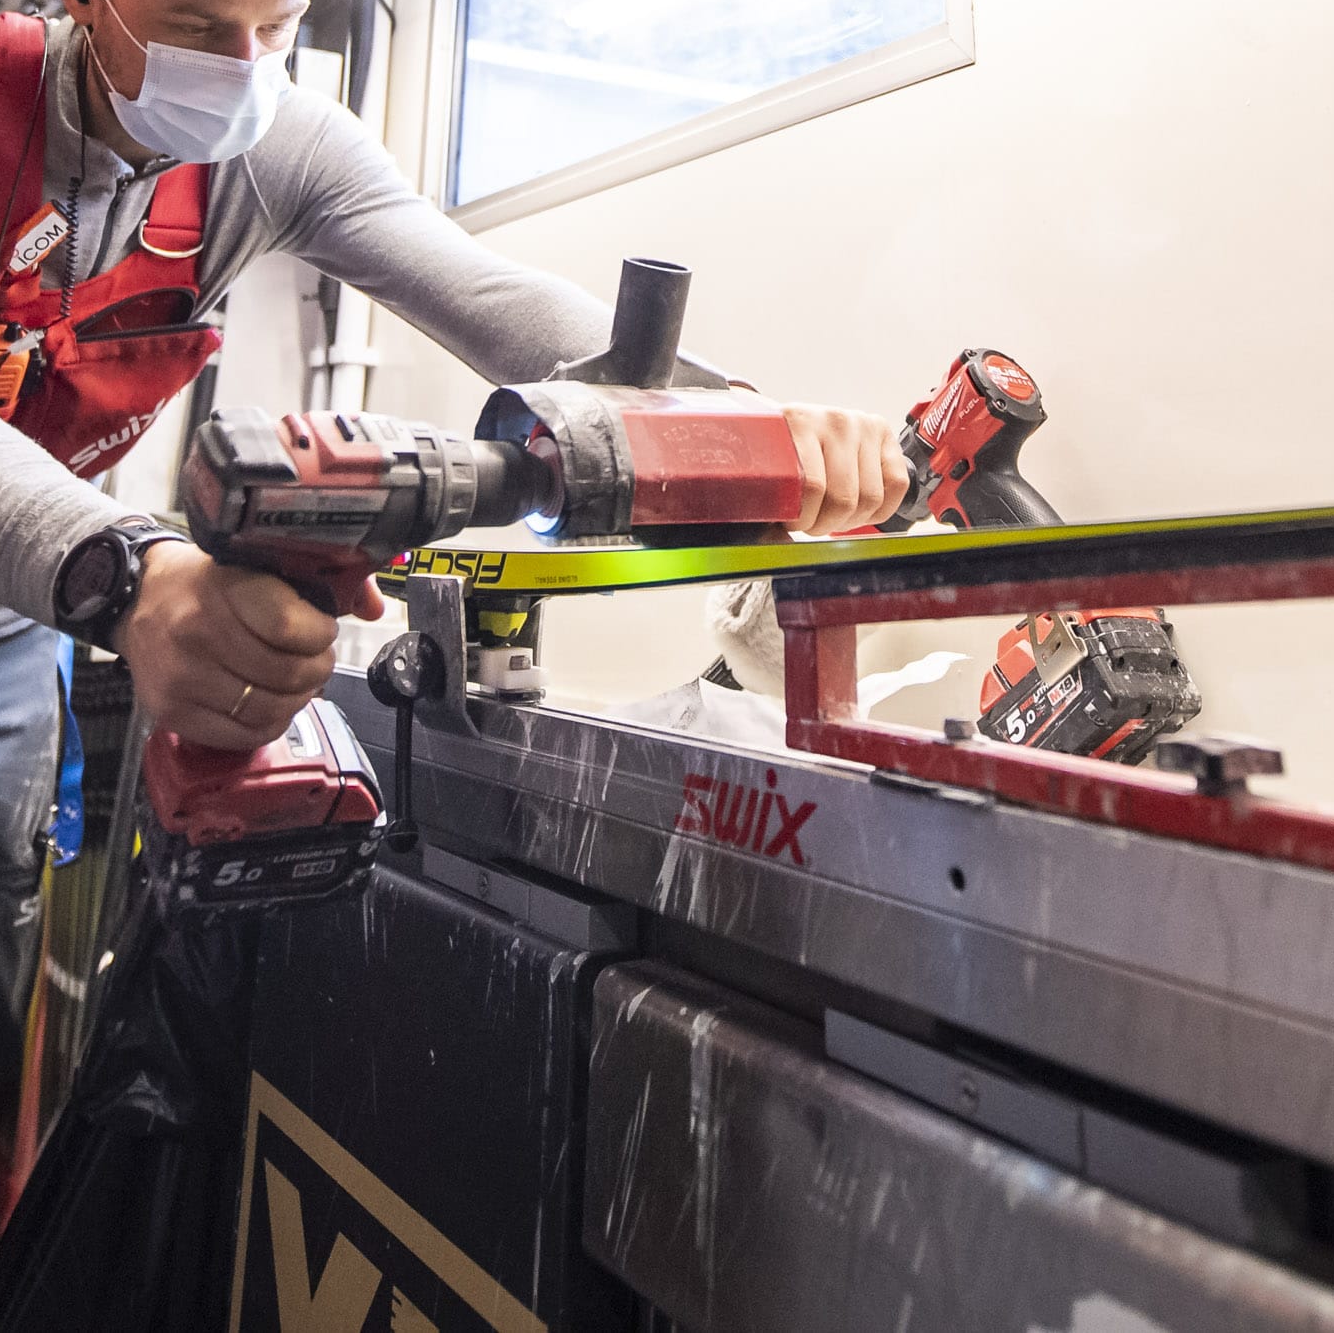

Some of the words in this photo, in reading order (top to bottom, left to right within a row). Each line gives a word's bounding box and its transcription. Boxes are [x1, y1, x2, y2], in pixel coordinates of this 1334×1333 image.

[17, 223, 65, 267] ICOM
[922, 375, 963, 437] Milwaukee
[1049, 677, 1075, 704] M18
[1005, 708, 1036, 743] 5.0
[213, 860, 263, 886] 5.0
